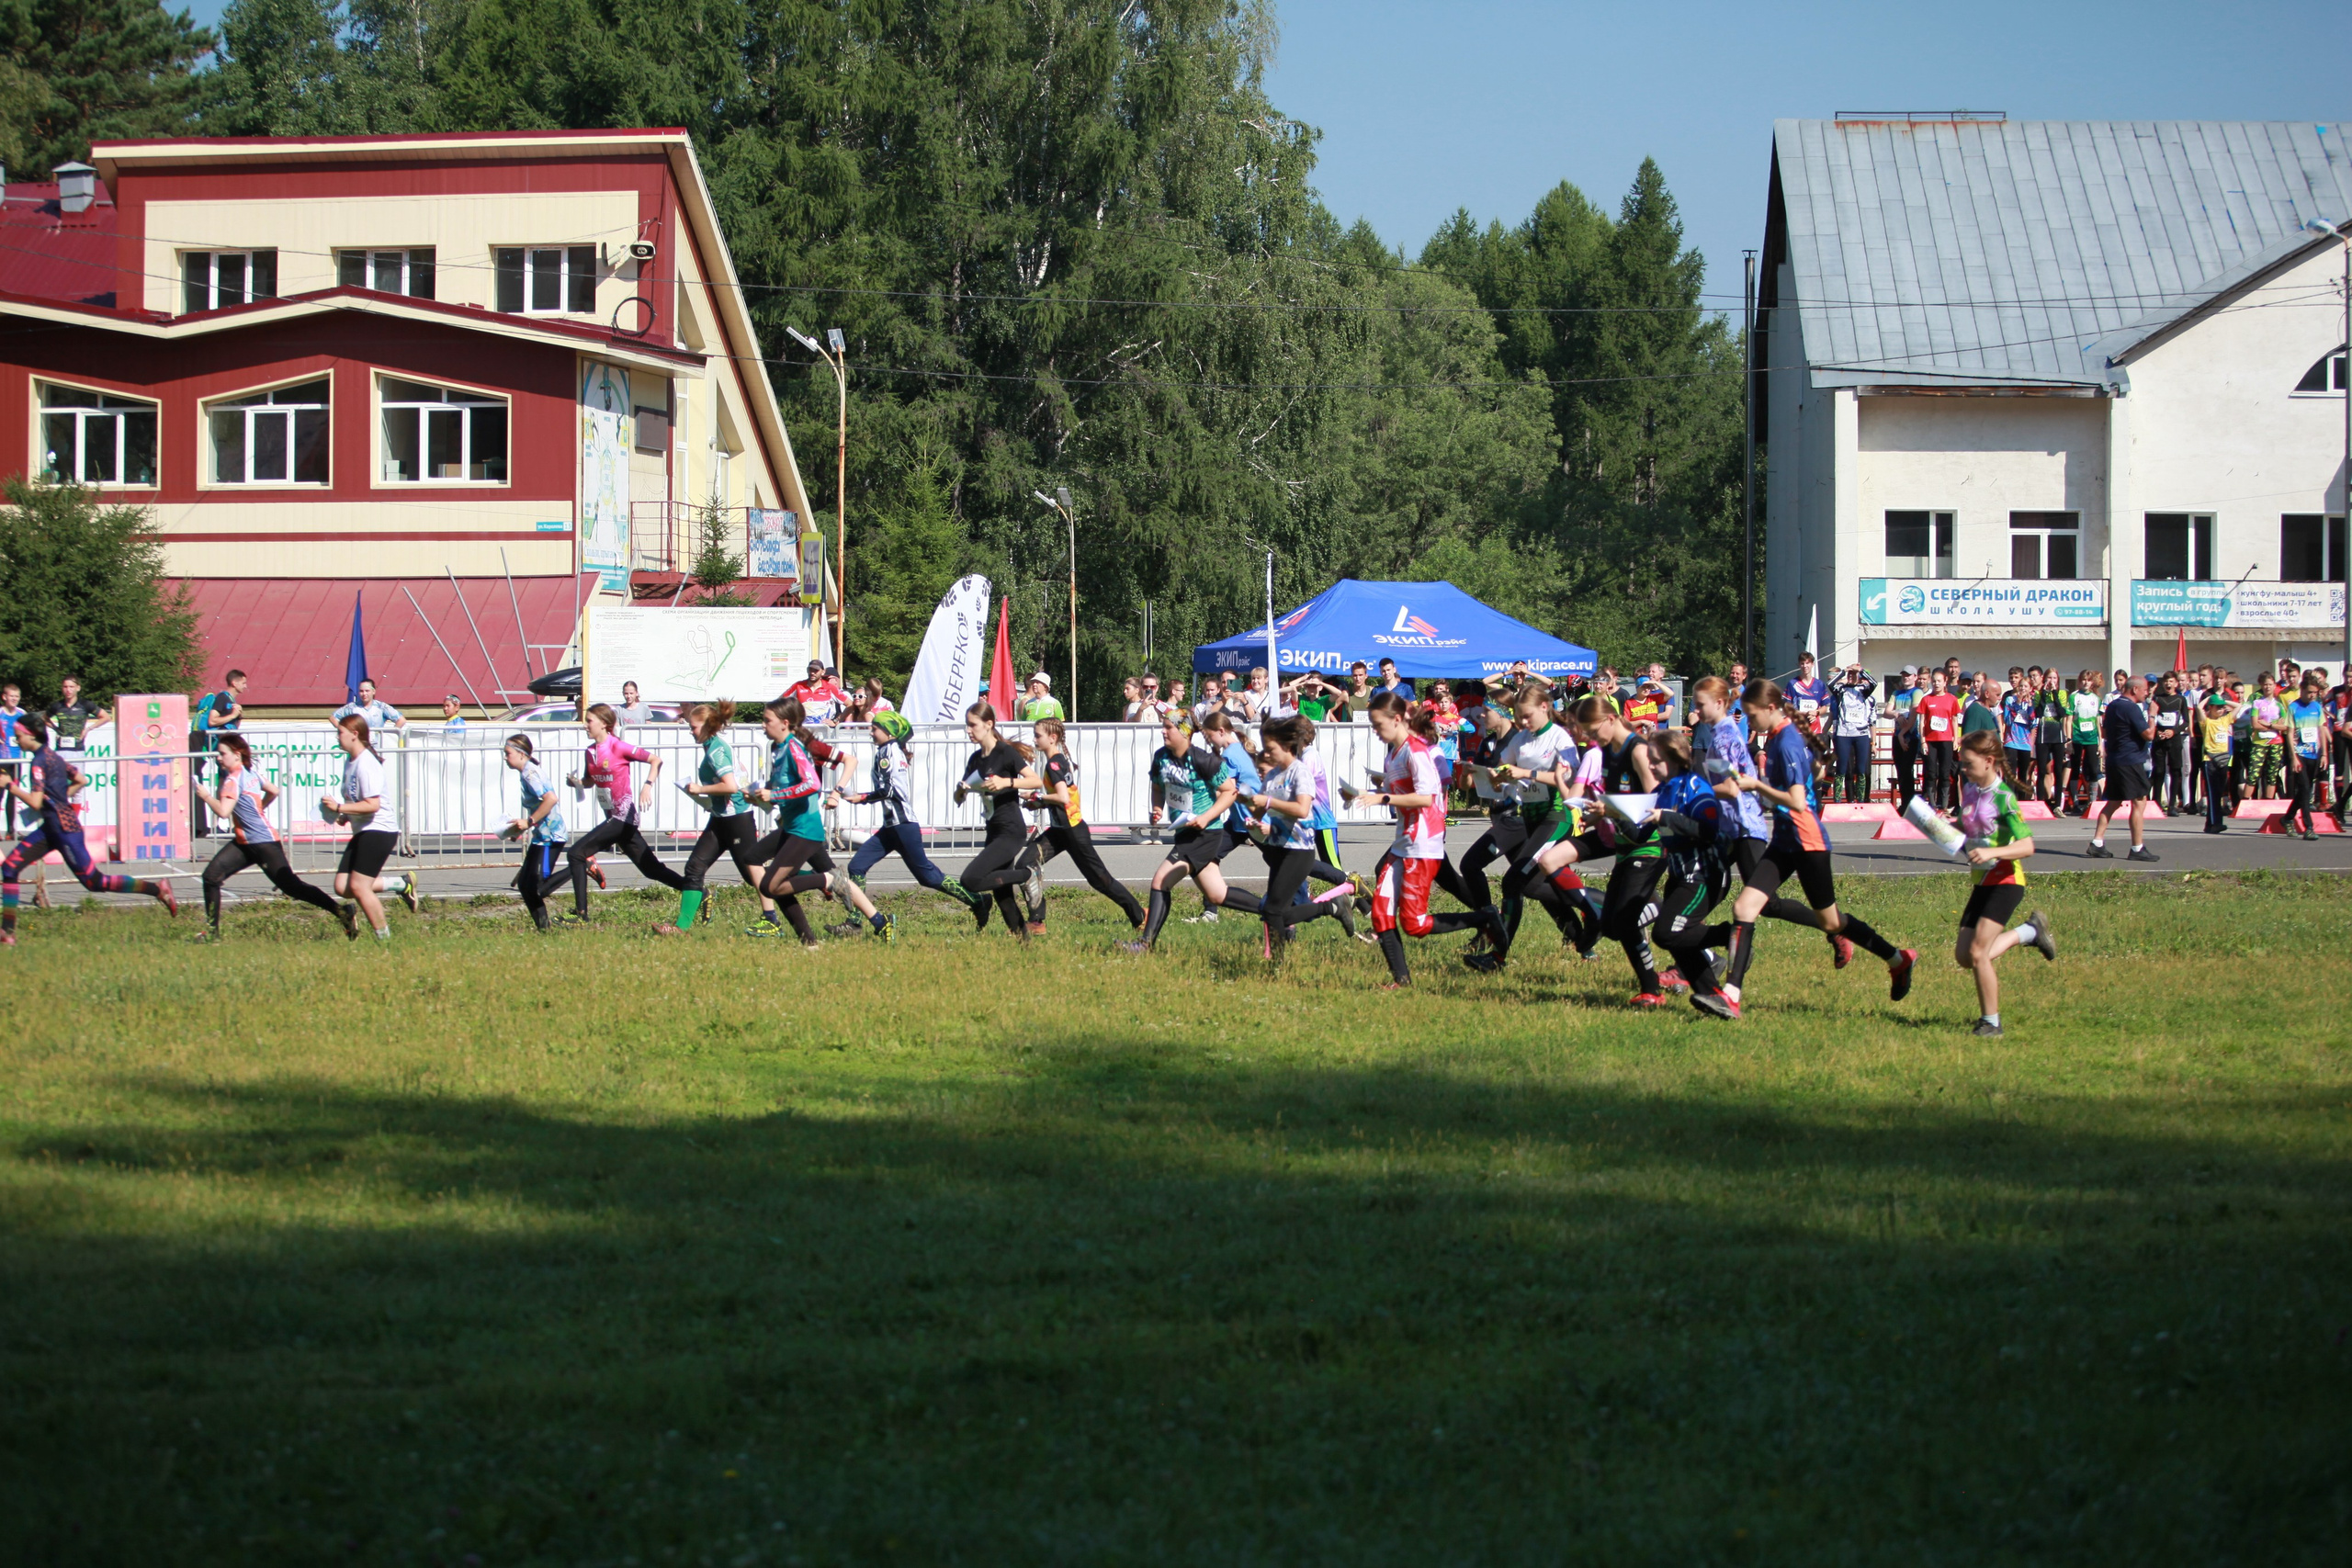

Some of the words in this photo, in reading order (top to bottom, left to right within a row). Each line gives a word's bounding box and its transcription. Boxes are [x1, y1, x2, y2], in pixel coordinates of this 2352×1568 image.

[1930, 586, 2020, 602] СЕВЕРНЫЙ
[2025, 589, 2093, 604] ДРАКОН
[2136, 585, 2183, 597] Запись
[2240, 590, 2305, 598] кунгфу-малыш
[2136, 600, 2192, 614] круглый
[2290, 599, 2306, 607] 7-17
[1930, 607, 1994, 615] ШКОЛА
[2009, 607, 2045, 615] УШУ
[1481, 659, 1593, 672] wwwkiprace.ru
